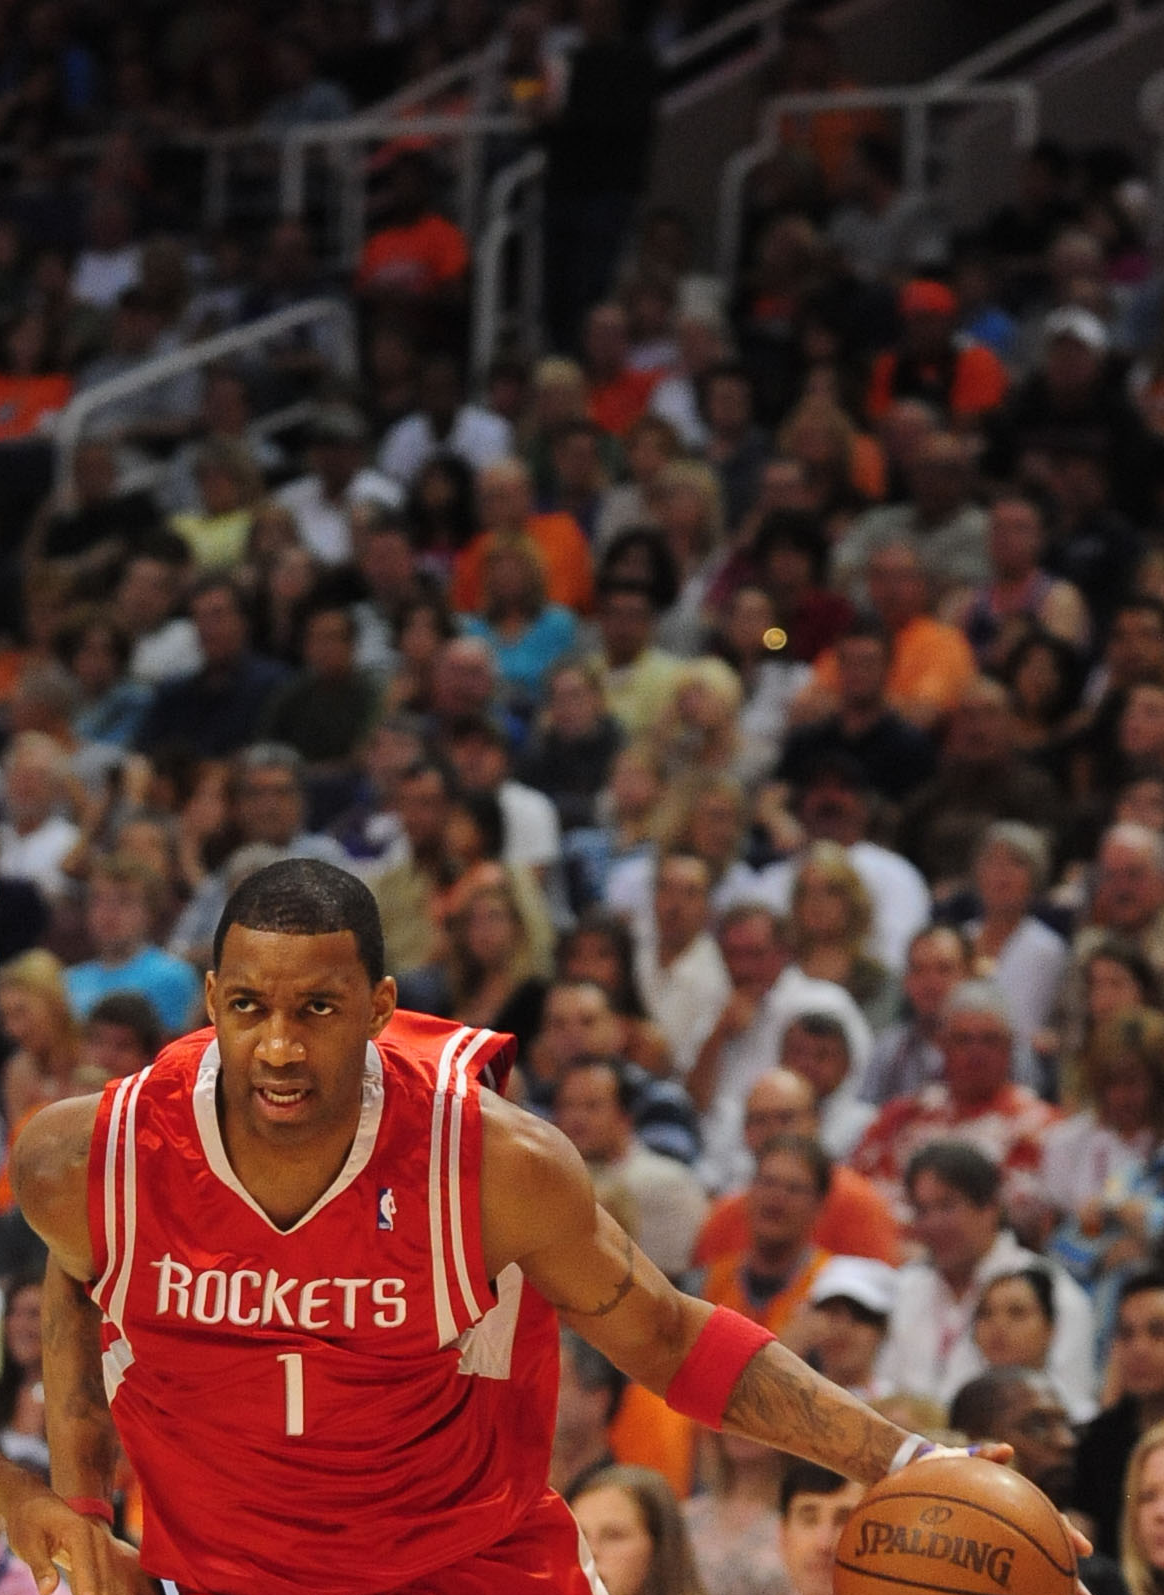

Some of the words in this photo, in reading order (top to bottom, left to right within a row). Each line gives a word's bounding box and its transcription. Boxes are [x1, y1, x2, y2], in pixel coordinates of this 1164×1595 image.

[150, 1252, 407, 1331] ROCKETS
[277, 1353, 304, 1436] 1
[854, 1519, 1015, 1587] SPALDING
